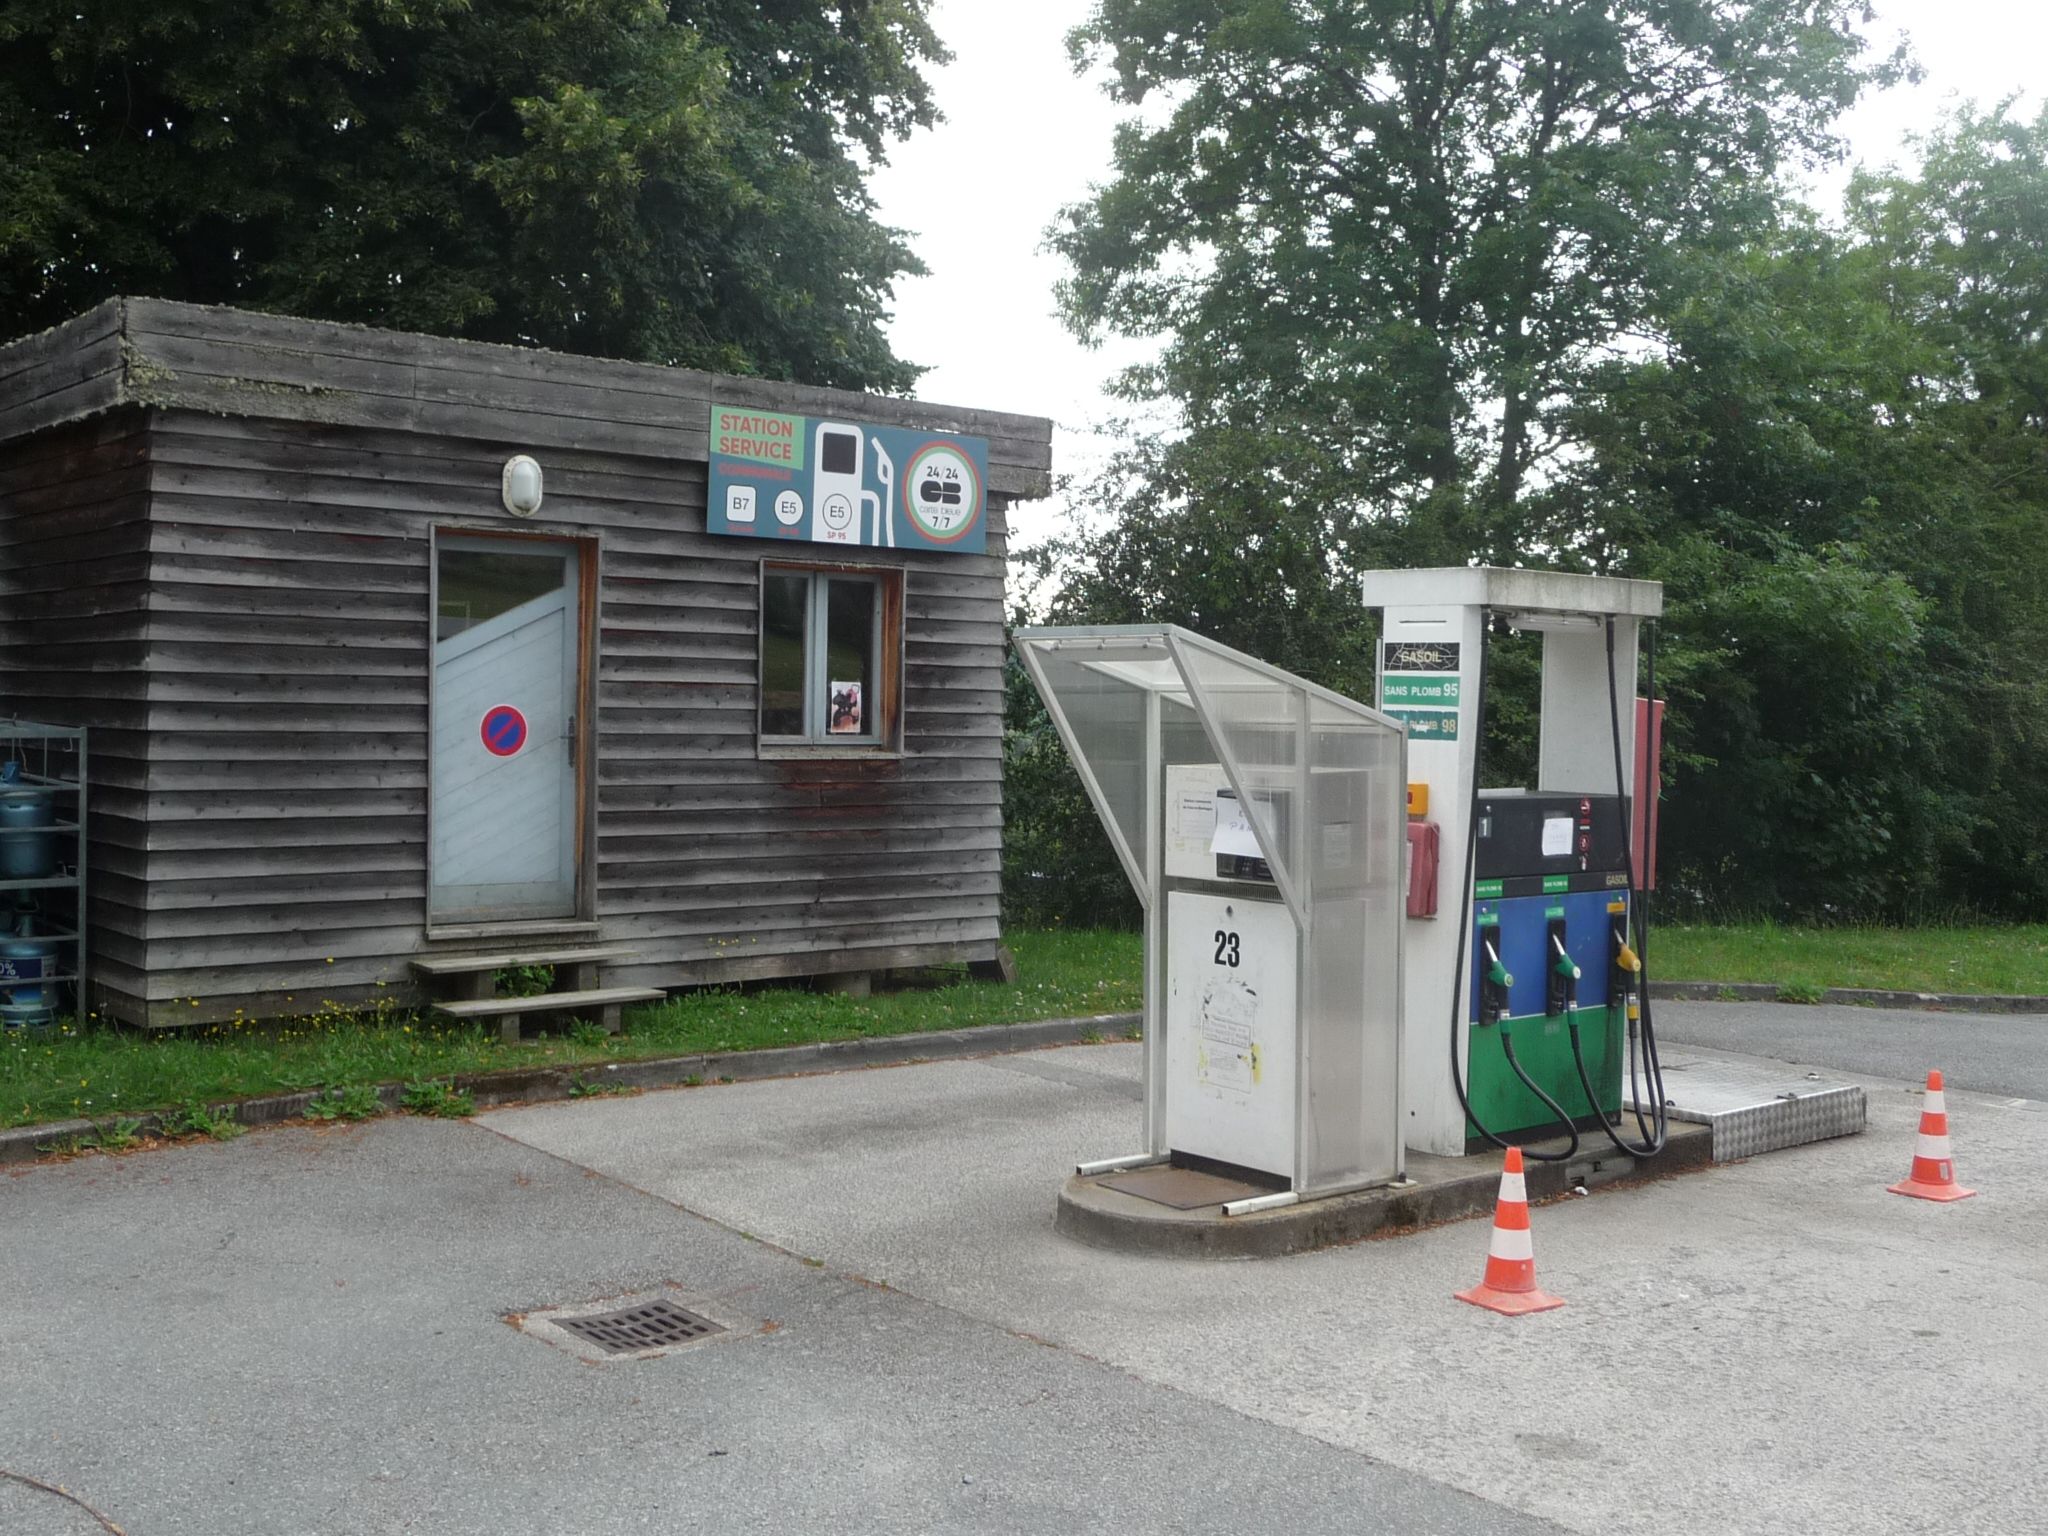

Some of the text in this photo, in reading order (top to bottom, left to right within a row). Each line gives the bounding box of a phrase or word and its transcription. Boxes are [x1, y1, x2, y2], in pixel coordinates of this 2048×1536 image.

[720, 414, 793, 438] STATION
[719, 435, 792, 460] SERVICE
[926, 465, 959, 480] 24/24
[732, 497, 750, 511] B7
[781, 501, 797, 515] E5
[829, 505, 845, 519] E5
[932, 516, 950, 528] 7/7
[827, 531, 847, 540] SP 95
[1401, 651, 1442, 663] GASOIL
[1384, 683, 1458, 697] SANS PLOMB 95
[1442, 718, 1456, 733] 98
[1481, 818, 1488, 836] 1
[1214, 929, 1240, 968] 23
